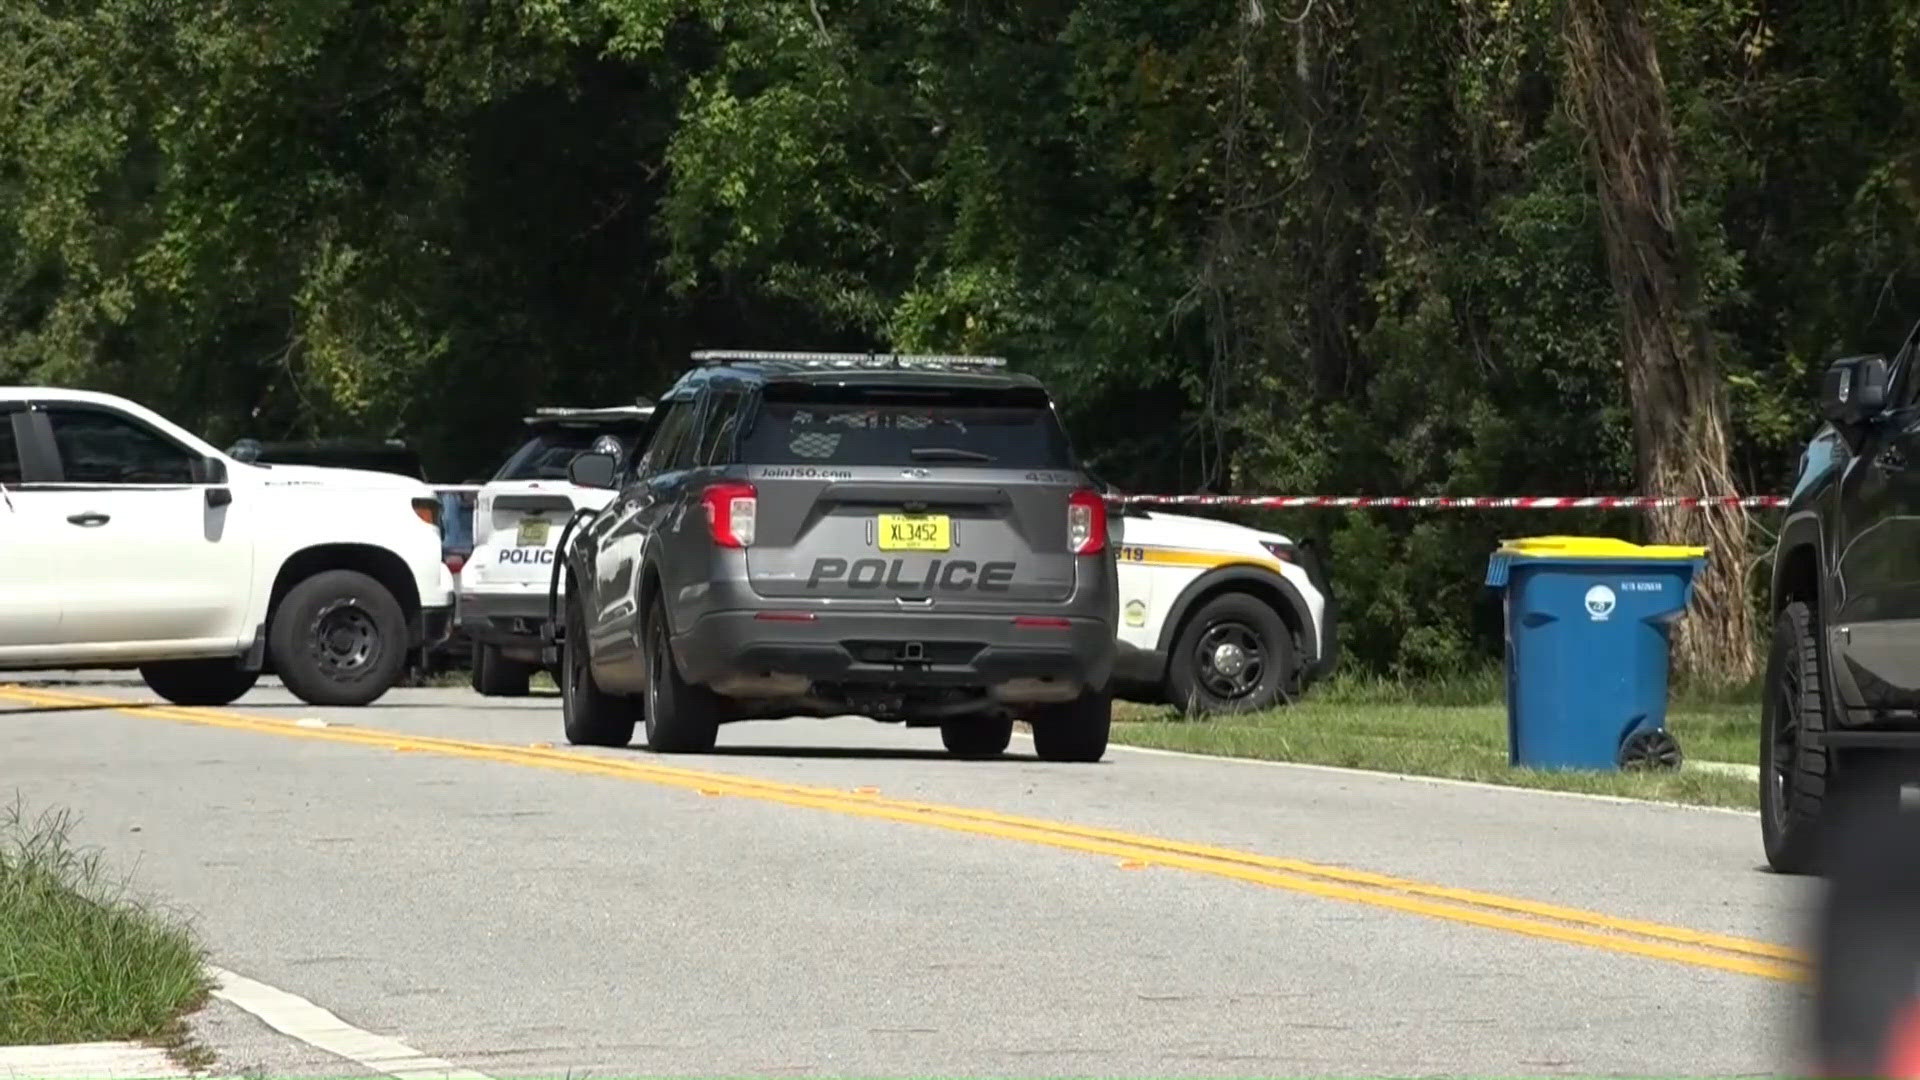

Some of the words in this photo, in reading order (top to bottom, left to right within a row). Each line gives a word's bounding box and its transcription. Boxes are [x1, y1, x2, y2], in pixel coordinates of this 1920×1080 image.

[891, 523, 938, 542] XL3452
[498, 548, 554, 565] POLIC
[806, 557, 1016, 592] POLICE
